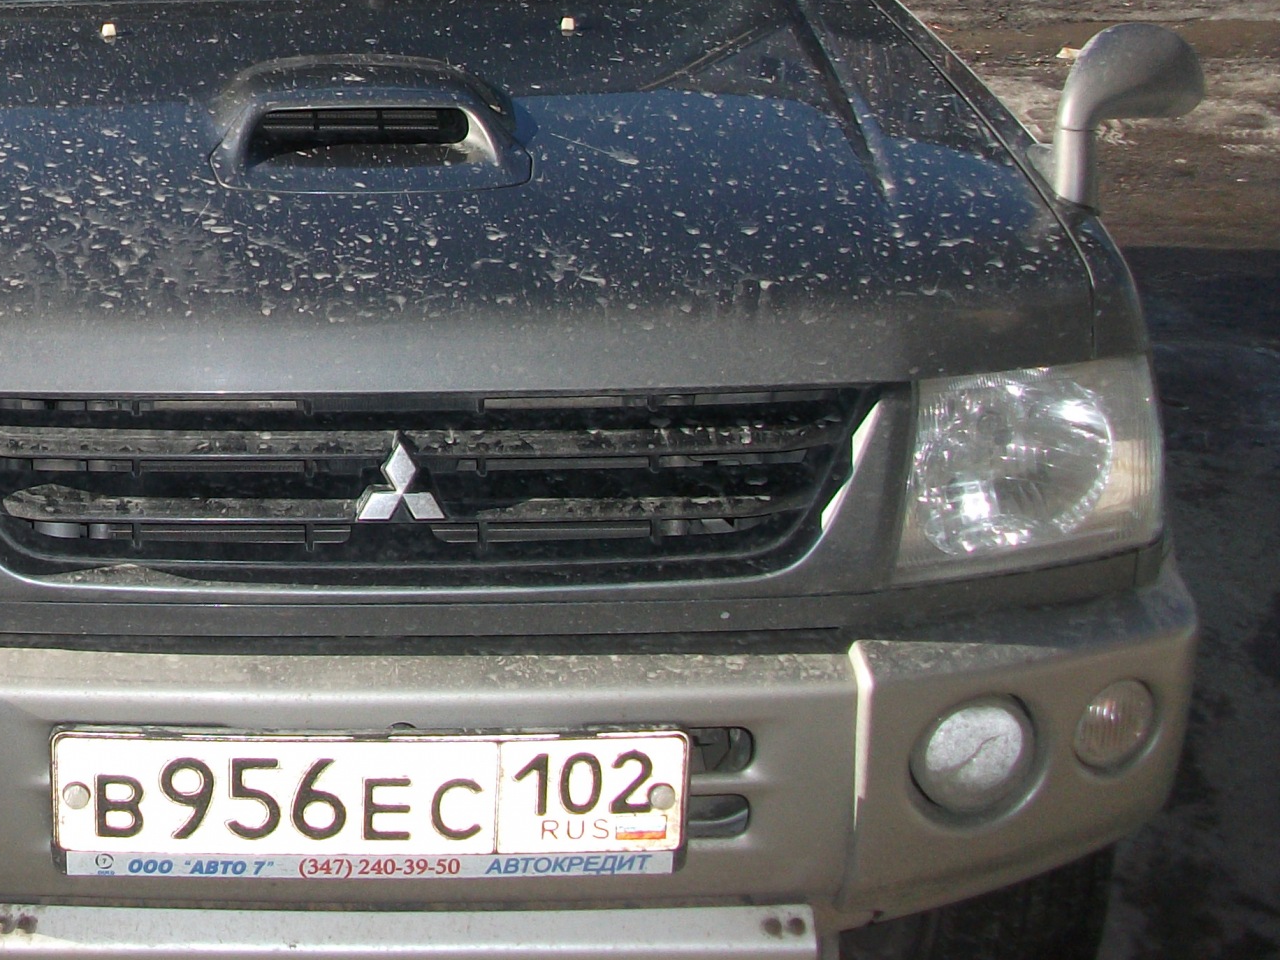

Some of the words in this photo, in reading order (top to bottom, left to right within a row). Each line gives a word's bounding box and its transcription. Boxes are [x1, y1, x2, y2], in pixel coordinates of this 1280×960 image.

[513, 748, 653, 816] 102
[541, 818, 609, 840] RUS
[298, 858, 353, 879] (347)
[358, 858, 461, 875] 240-39-50
[485, 854, 653, 874] АВТОКРЕДИТ
